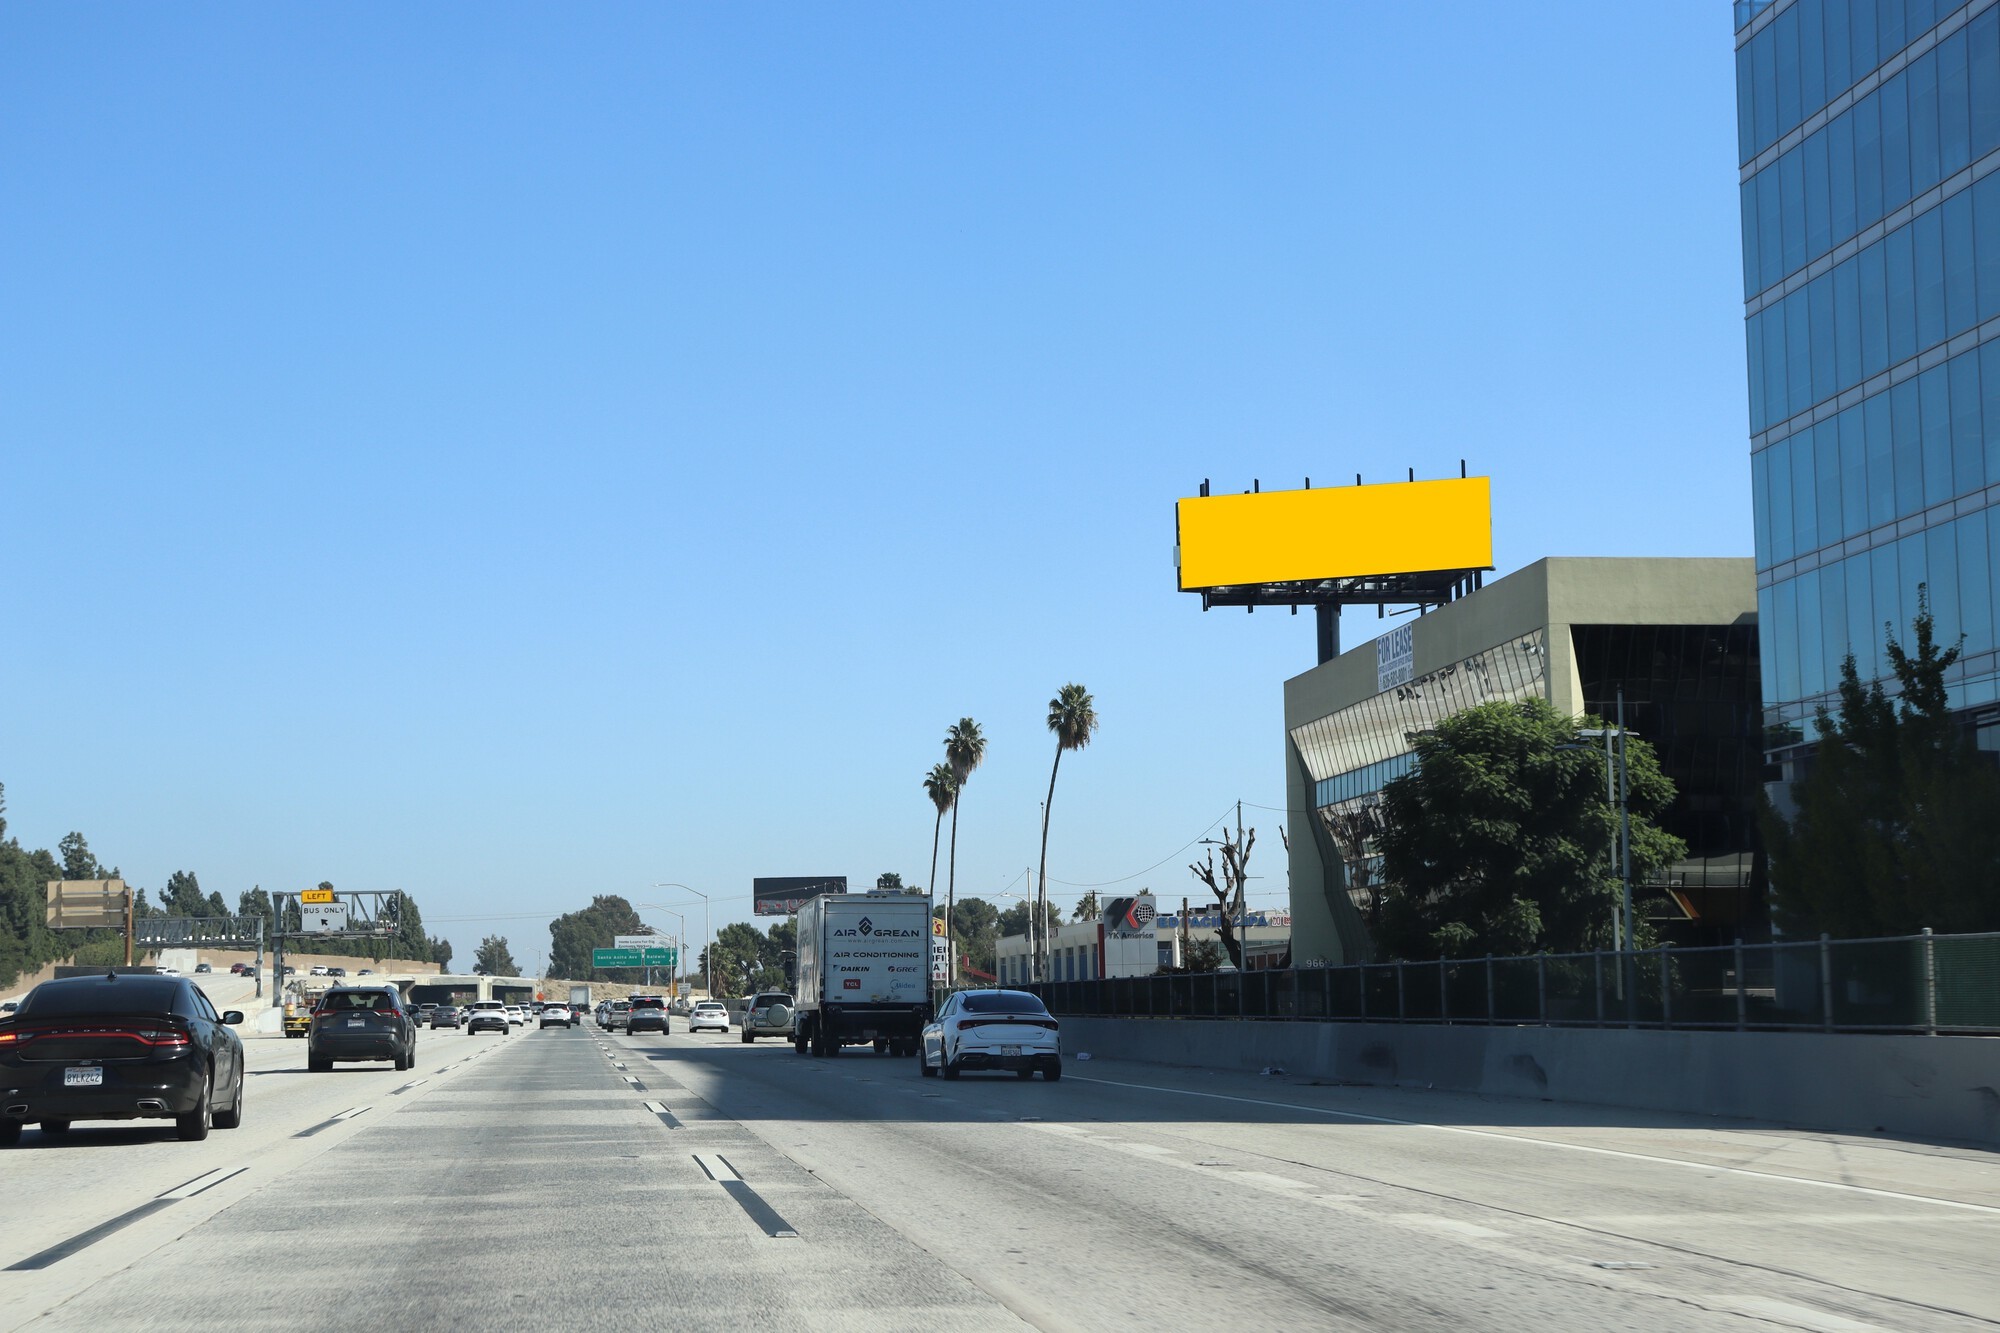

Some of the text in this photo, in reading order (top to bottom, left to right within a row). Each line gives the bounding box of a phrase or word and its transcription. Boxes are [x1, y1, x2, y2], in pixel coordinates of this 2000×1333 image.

[1378, 635, 1391, 665] FOR
[1391, 625, 1412, 659] LEASE
[833, 929, 920, 938] AIR GREAN
[1108, 931, 1154, 939] YK America
